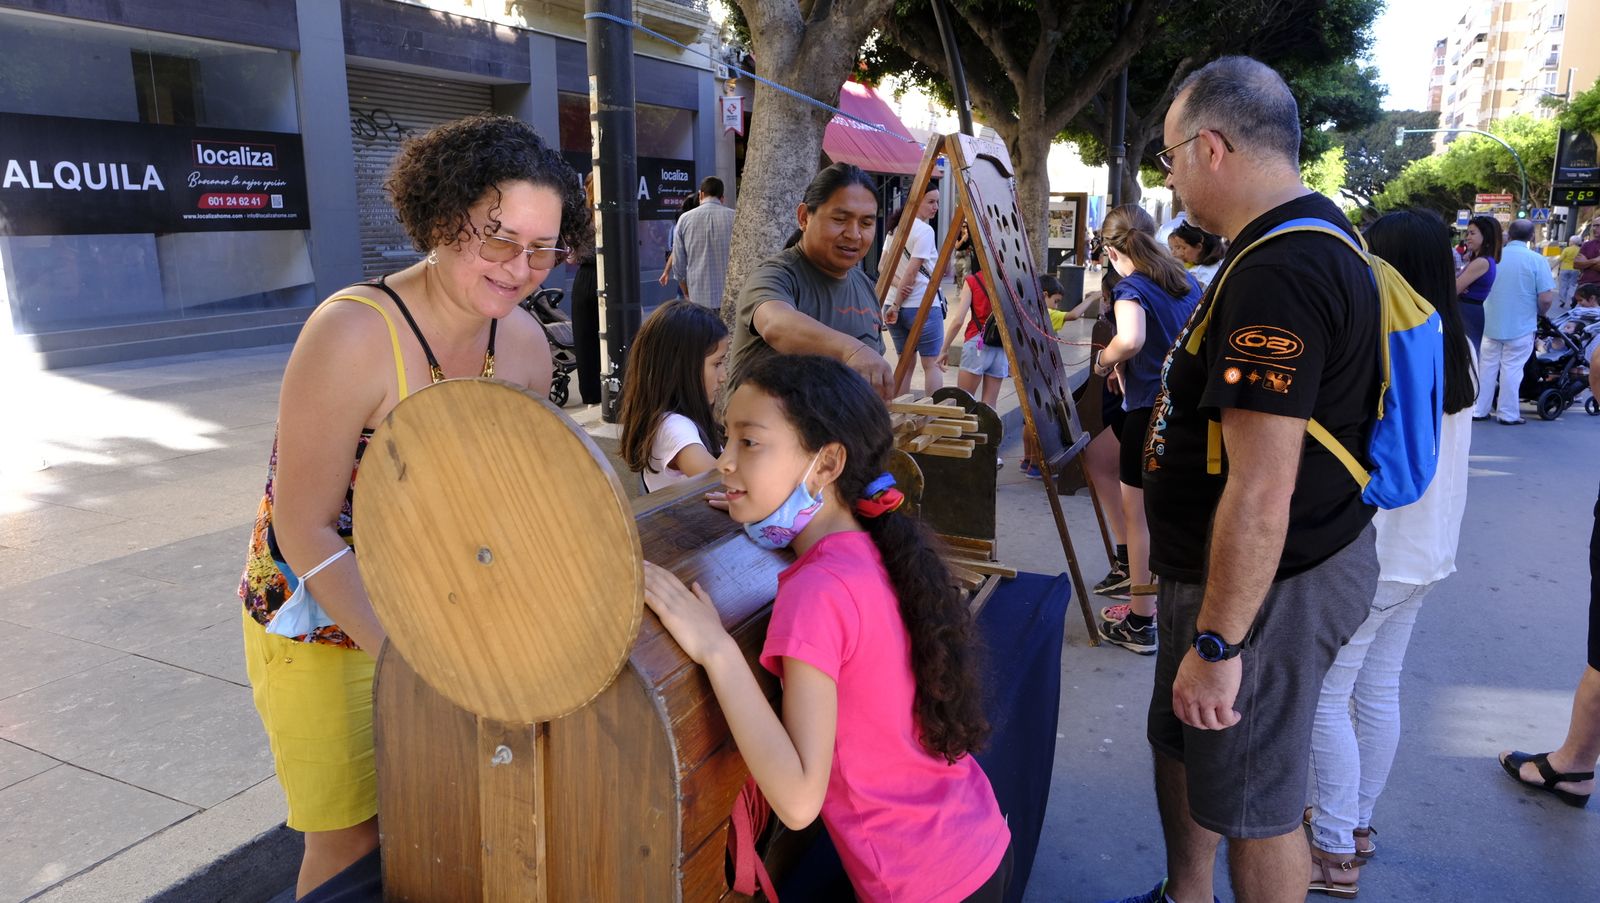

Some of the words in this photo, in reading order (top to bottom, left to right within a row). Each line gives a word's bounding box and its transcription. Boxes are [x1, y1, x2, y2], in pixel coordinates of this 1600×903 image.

[197, 144, 273, 167] localiza
[2, 159, 165, 191] ALQUILA
[661, 168, 688, 181] localiza
[208, 196, 224, 206] 601
[226, 196, 237, 206] 24
[239, 196, 250, 206] 62
[251, 197, 261, 206] 41
